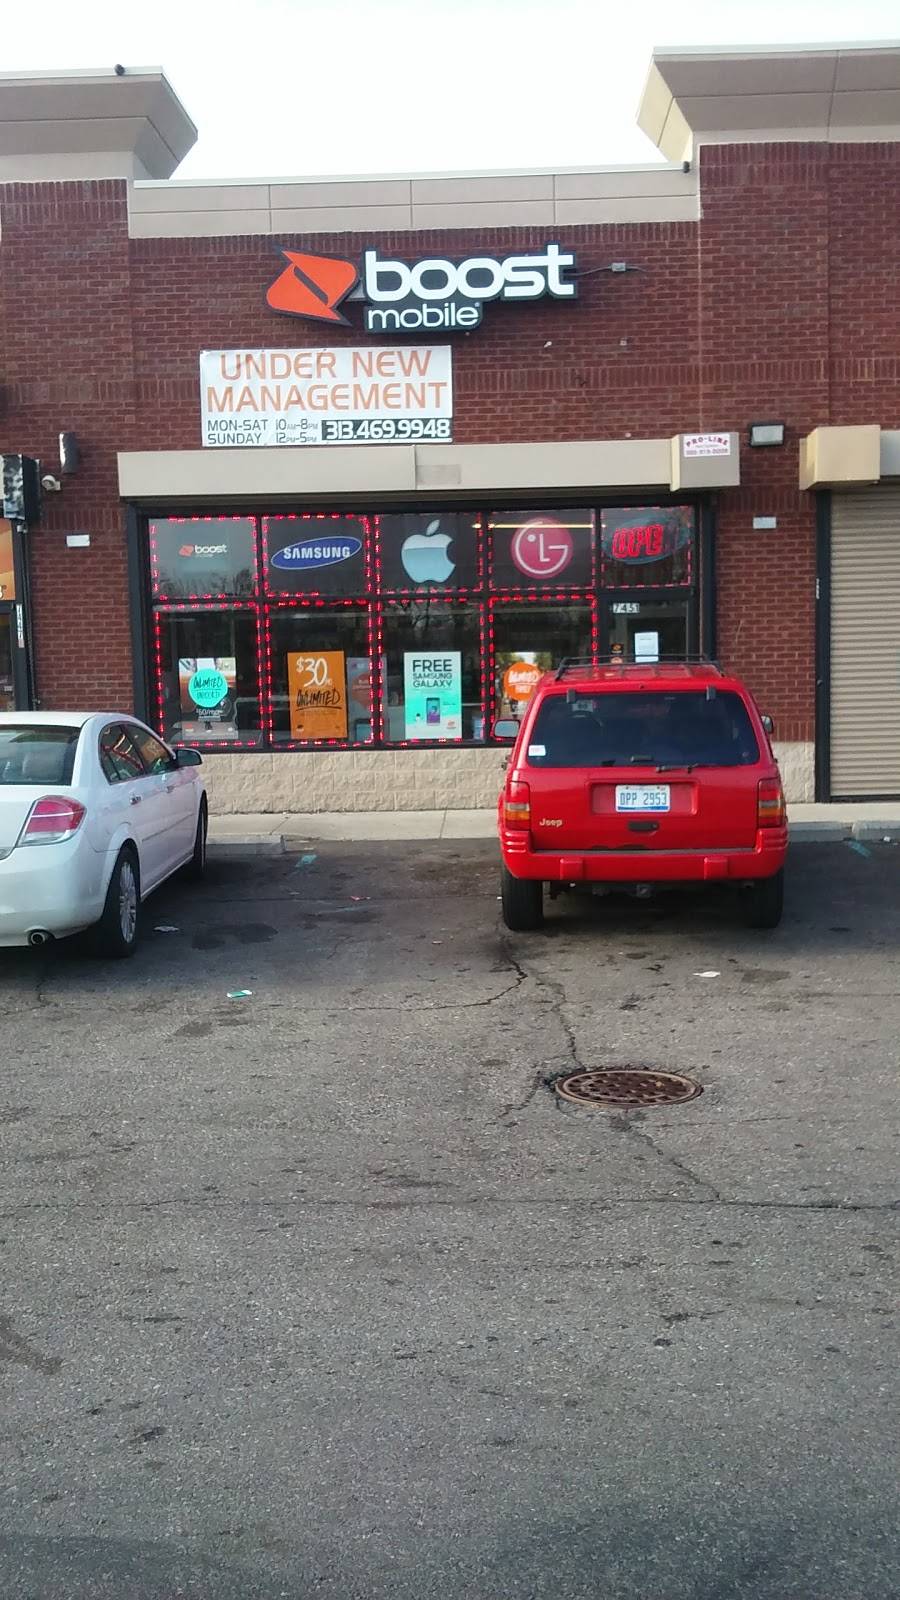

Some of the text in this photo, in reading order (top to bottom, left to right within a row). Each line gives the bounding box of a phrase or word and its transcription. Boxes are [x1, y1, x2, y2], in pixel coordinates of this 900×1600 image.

[365, 244, 574, 302] boost
[368, 302, 479, 330] mobile
[220, 350, 432, 380] UNDER NEW
[207, 382, 448, 412] MANAGEMENT
[207, 419, 268, 431] MON-SAT
[325, 419, 450, 440] 313.469.9948
[207, 432, 262, 444] SUNDAY
[686, 436, 728, 447] PRO-LINE
[612, 522, 680, 558] OPE
[194, 544, 228, 554] boost
[283, 546, 350, 560] SAMSUNG
[514, 520, 570, 576] LG
[412, 659, 452, 672] FREE
[412, 672, 452, 680] SAMSUNG
[412, 680, 453, 688] GALAXY
[643, 792, 667, 805] 2953
[539, 818, 562, 828] Jeep
